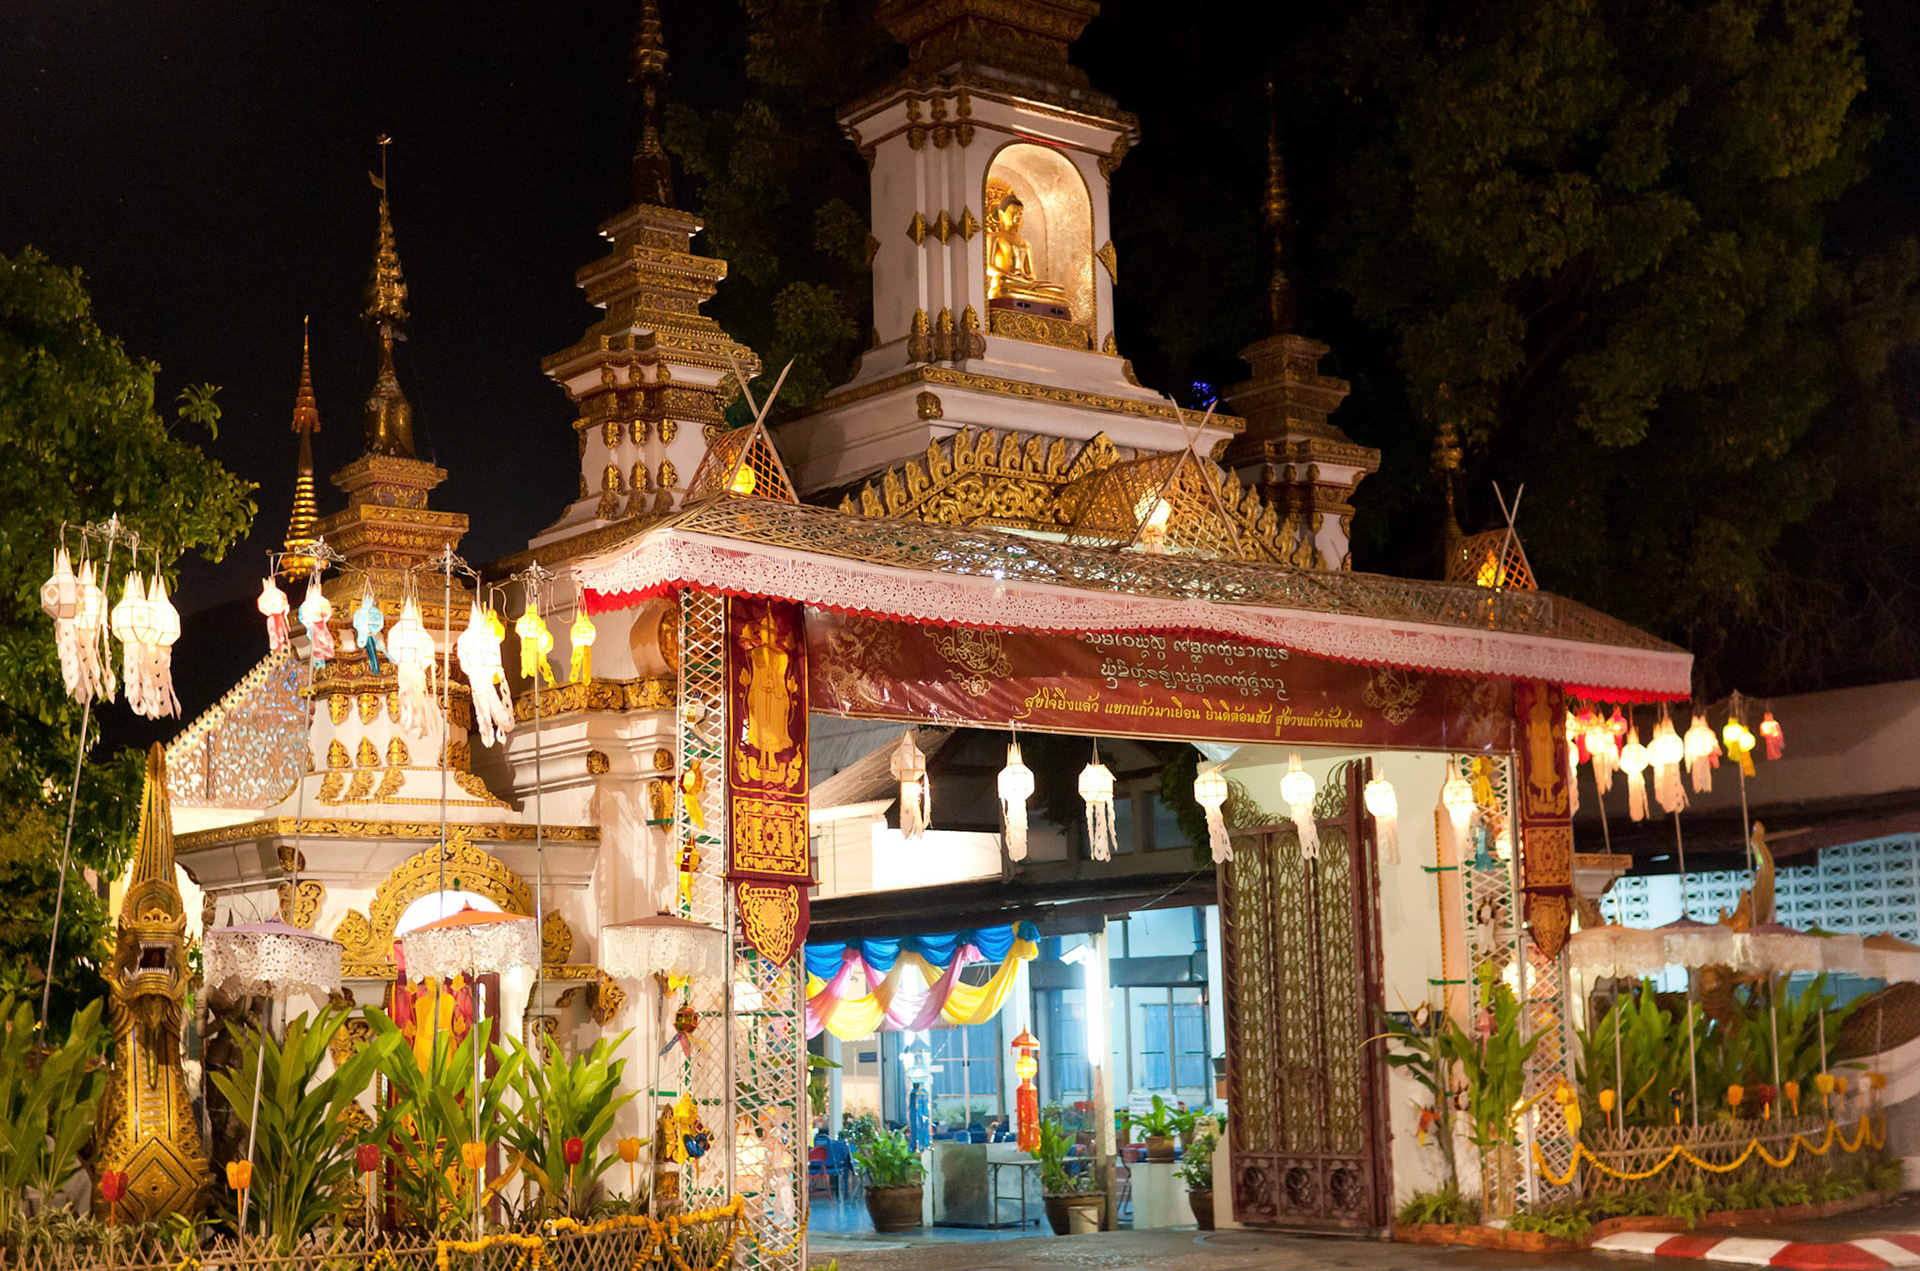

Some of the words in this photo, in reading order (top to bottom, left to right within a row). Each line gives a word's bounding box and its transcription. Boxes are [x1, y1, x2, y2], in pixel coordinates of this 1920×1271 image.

[1012, 686, 1100, 719] สุขใจ๋ยิ่งแล้ว
[1104, 696, 1201, 720] แขกแก้วมาเยือน
[1202, 697, 1273, 725] ยินดีต้อนฮับ
[1274, 704, 1364, 737] สู่ข่วงแก้วทั้งสาม
